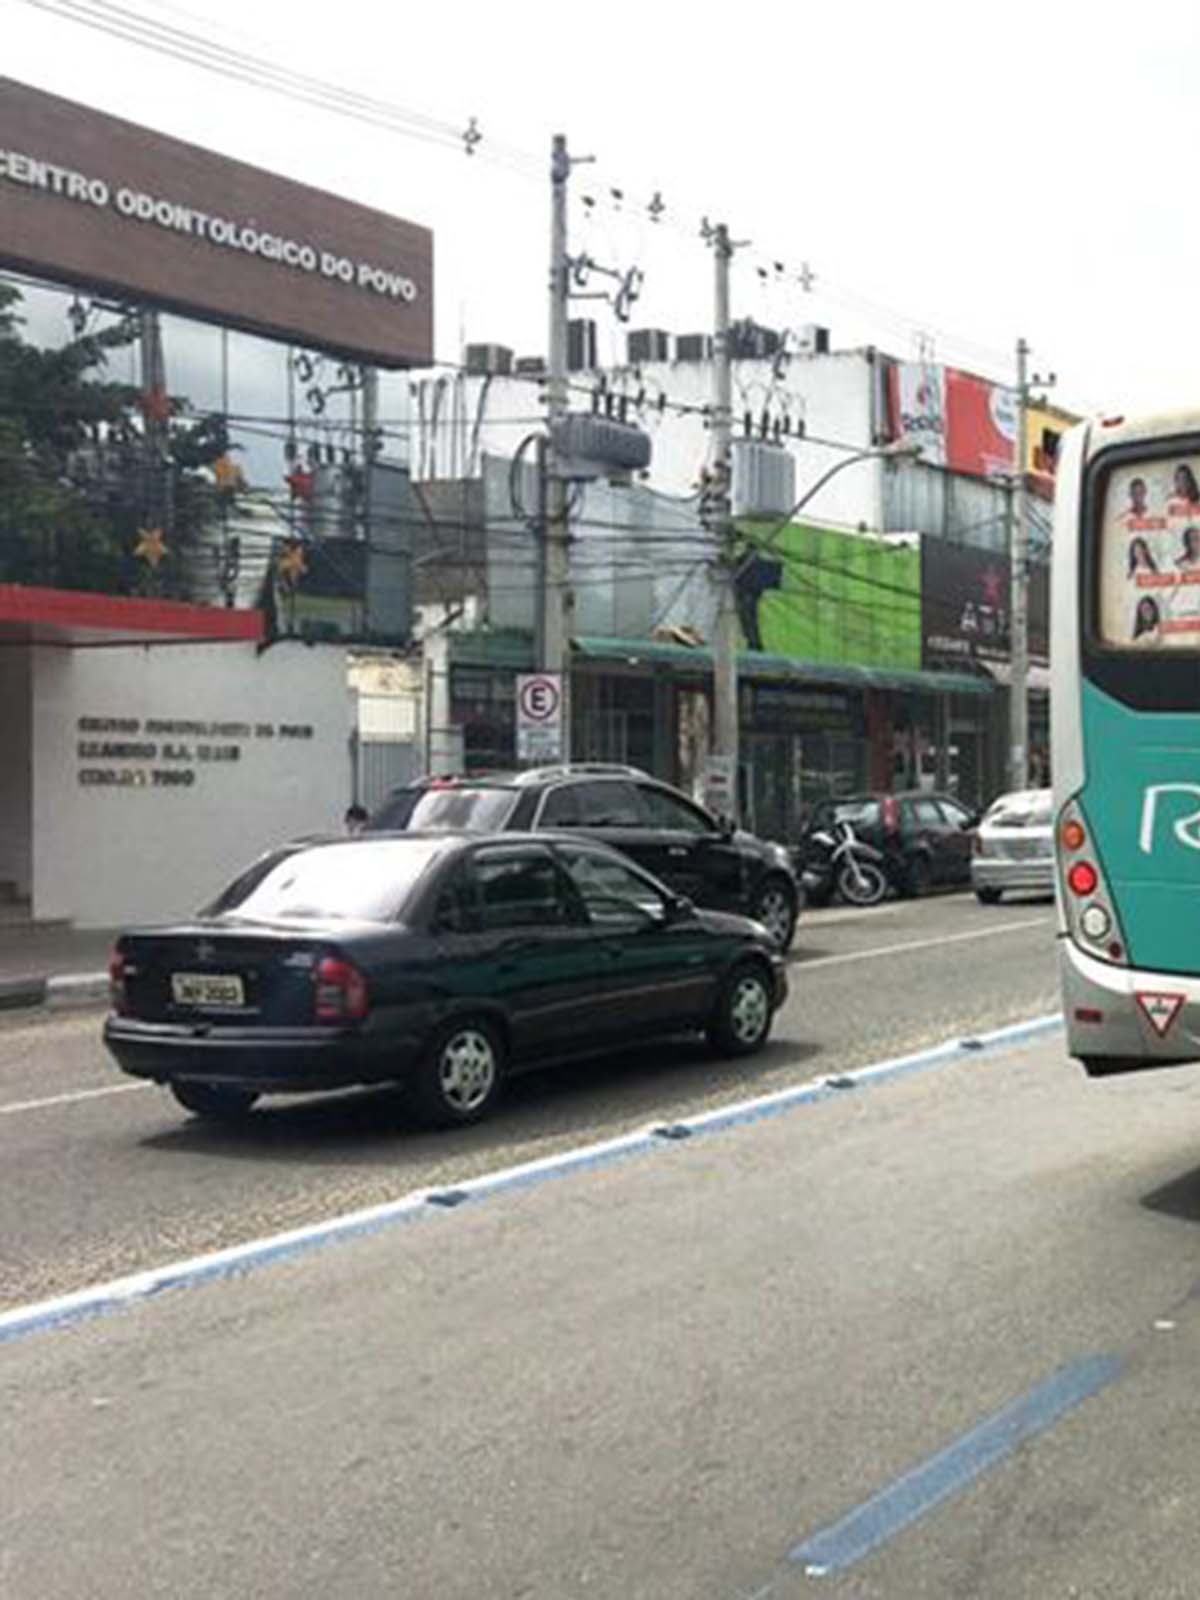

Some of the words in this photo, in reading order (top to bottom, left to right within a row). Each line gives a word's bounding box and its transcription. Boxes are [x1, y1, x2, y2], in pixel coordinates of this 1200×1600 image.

[321, 252, 354, 282] DO
[358, 263, 417, 302] POVO
[531, 687, 545, 711] E
